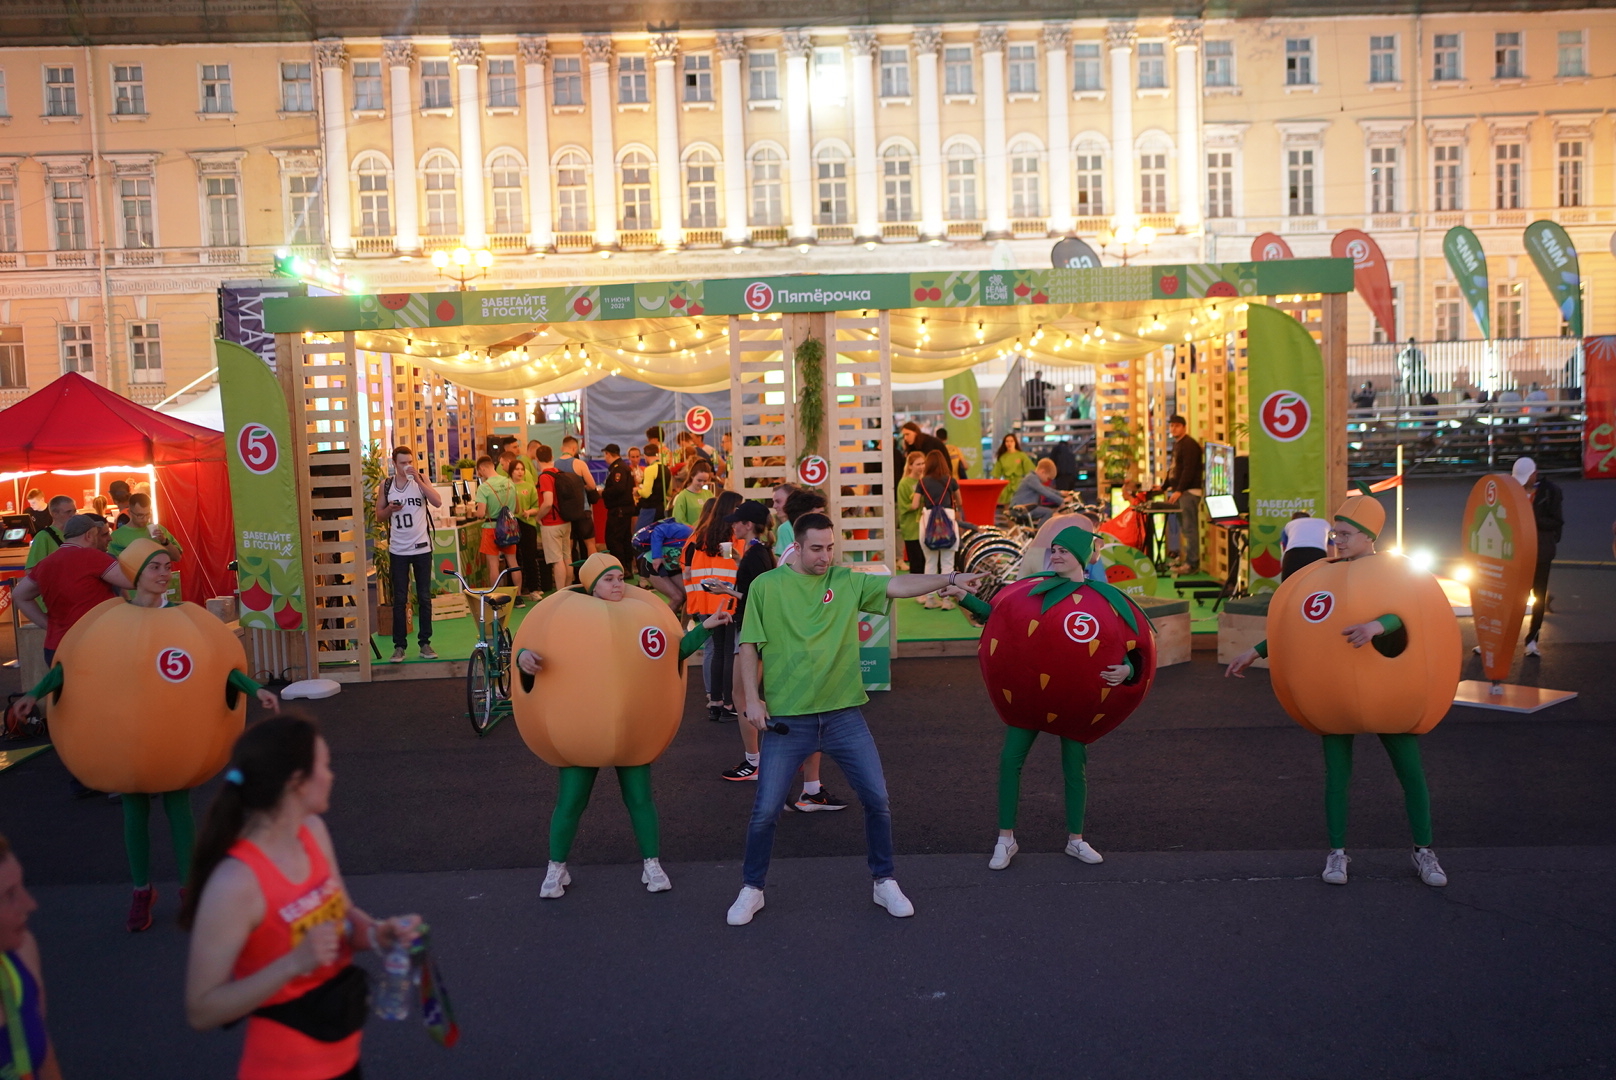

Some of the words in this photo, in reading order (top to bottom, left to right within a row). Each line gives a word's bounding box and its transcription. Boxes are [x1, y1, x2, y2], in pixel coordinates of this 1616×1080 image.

[1048, 275, 1152, 287] САНКТ-ПЕТЕРБУРГ
[1048, 284, 1152, 296] САНКТ-ПЕТЕРБУРГ
[481, 294, 547, 307] ЗАБЕГАЙТЕ
[778, 289, 871, 305] Пятёрочка
[482, 308, 490, 317] В
[493, 306, 533, 317] ГОСТИ
[1256, 497, 1315, 509] ЗАБЕГАЙТЕ
[1257, 508, 1263, 517] В
[395, 513, 413, 529] 10
[242, 530, 291, 542] ЗАБЕГАЙТЕ
[243, 540, 250, 548] В
[253, 541, 281, 550] ГОСТИ
